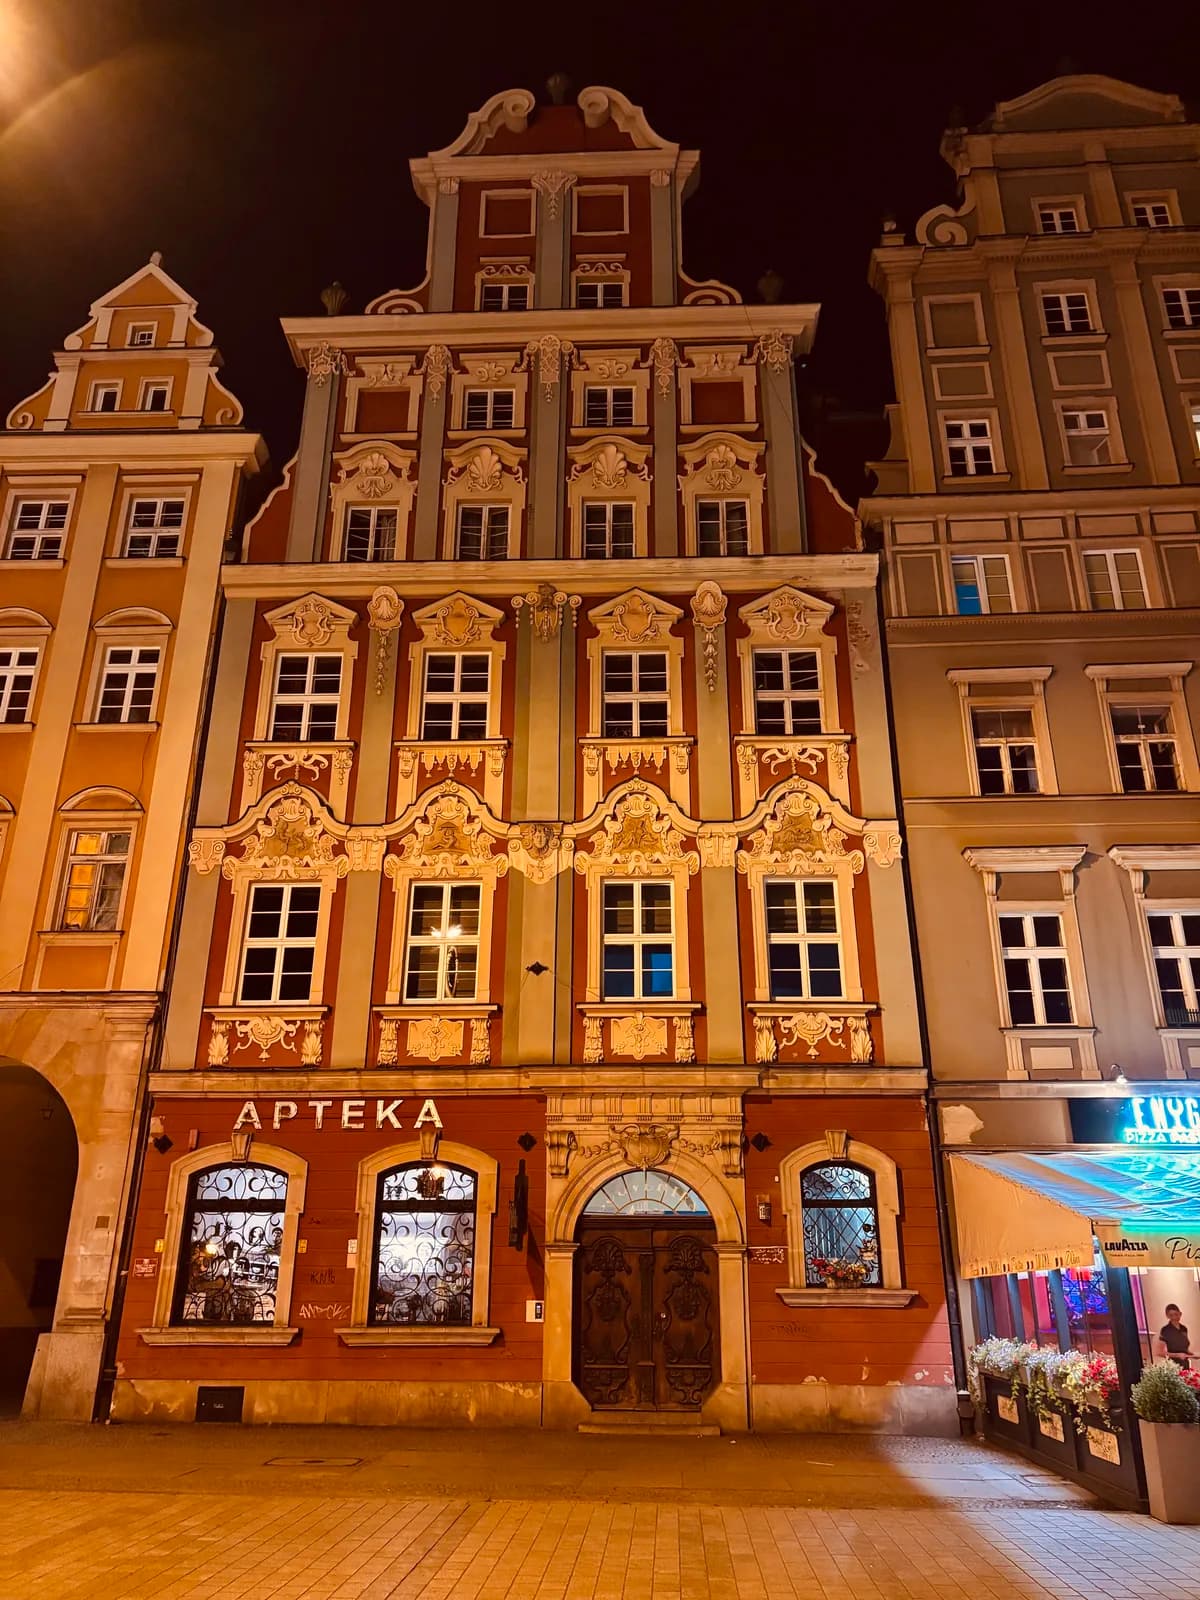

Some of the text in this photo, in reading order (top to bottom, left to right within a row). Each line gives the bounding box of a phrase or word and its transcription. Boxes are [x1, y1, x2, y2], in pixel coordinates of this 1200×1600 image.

[232, 1099, 444, 1130] APTEKA
[1125, 1130, 1168, 1144] PIZZA
[1104, 1238, 1149, 1251] LAVAZZA
